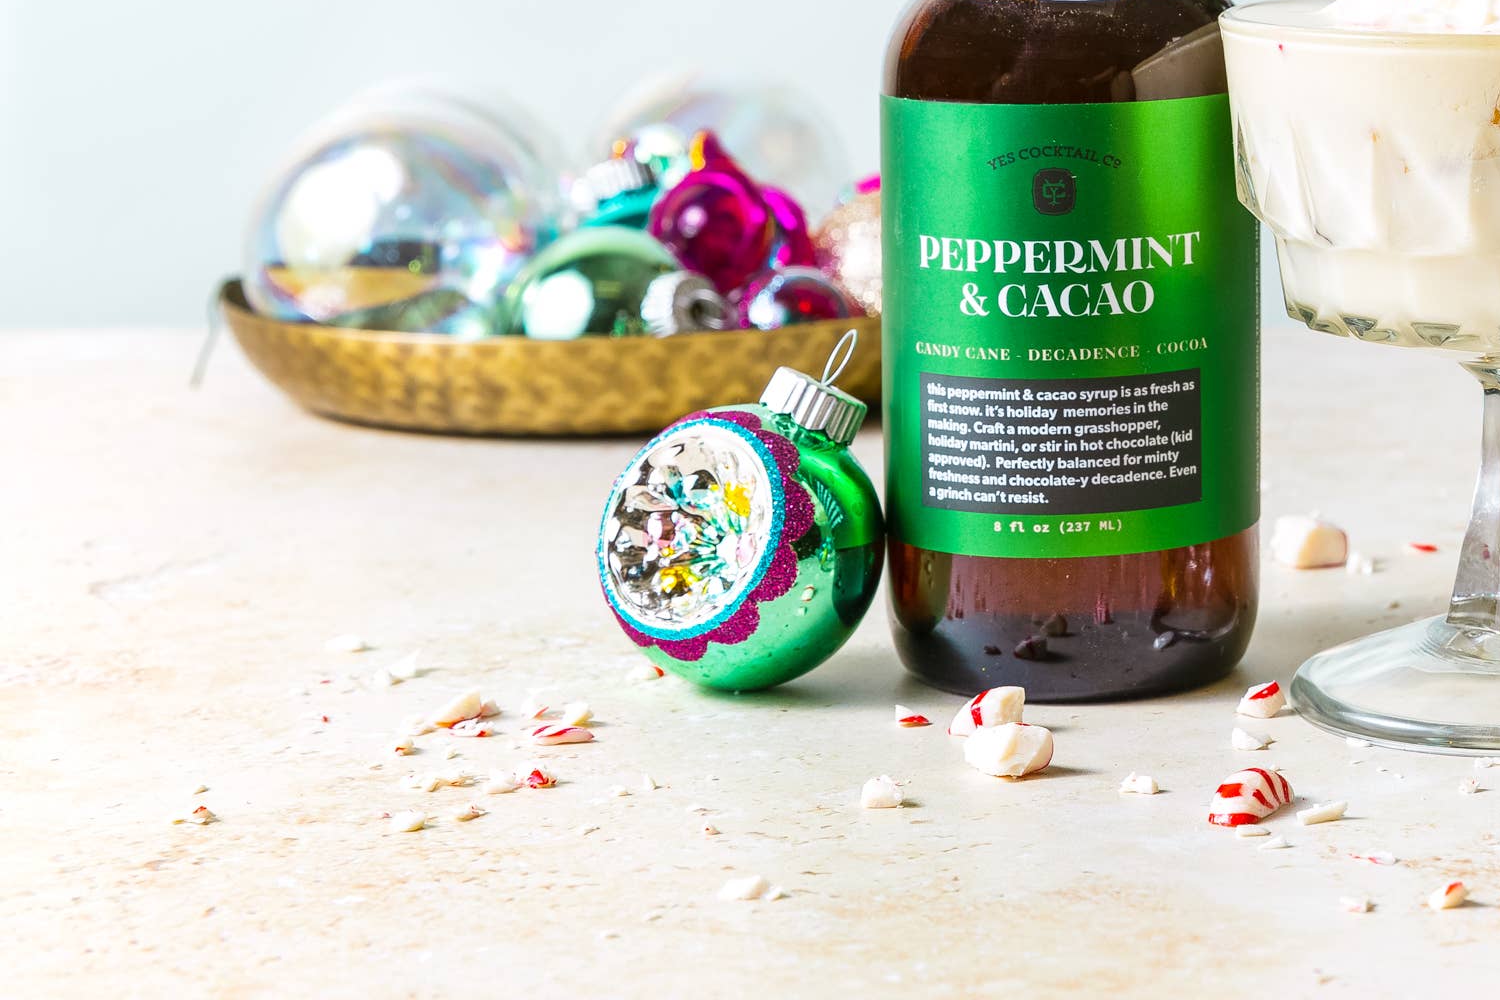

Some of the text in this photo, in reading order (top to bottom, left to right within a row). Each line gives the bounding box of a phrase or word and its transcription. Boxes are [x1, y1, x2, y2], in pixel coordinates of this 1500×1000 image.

[987, 152, 1015, 170] YES
[1018, 146, 1100, 163] COCKTAIL
[919, 231, 1200, 274] PEPPERMINT
[959, 280, 1154, 317] & CACAO
[916, 341, 960, 358] CANDY
[965, 347, 1010, 361] CANE
[1028, 345, 1140, 361] DECADENCE
[1156, 337, 1208, 354] COCOA
[927, 380, 1194, 403] this peppermint & cacao syrup is as fresh as
[927, 400, 1168, 420] first snow. it’s holiday memories in the
[927, 418, 1161, 436] making. Craft a modern grasshopper,
[928, 429, 1193, 453] holiday martini, or stir in hot chocolate (kid
[928, 451, 1180, 472] approved). Perfectly balanced for minty
[928, 464, 1197, 488] freshness and chocolate-y decadence. Even
[929, 486, 1049, 504] a grinch can’t resist.
[993, 520, 1122, 534] 8 fl oz (237 ML)
